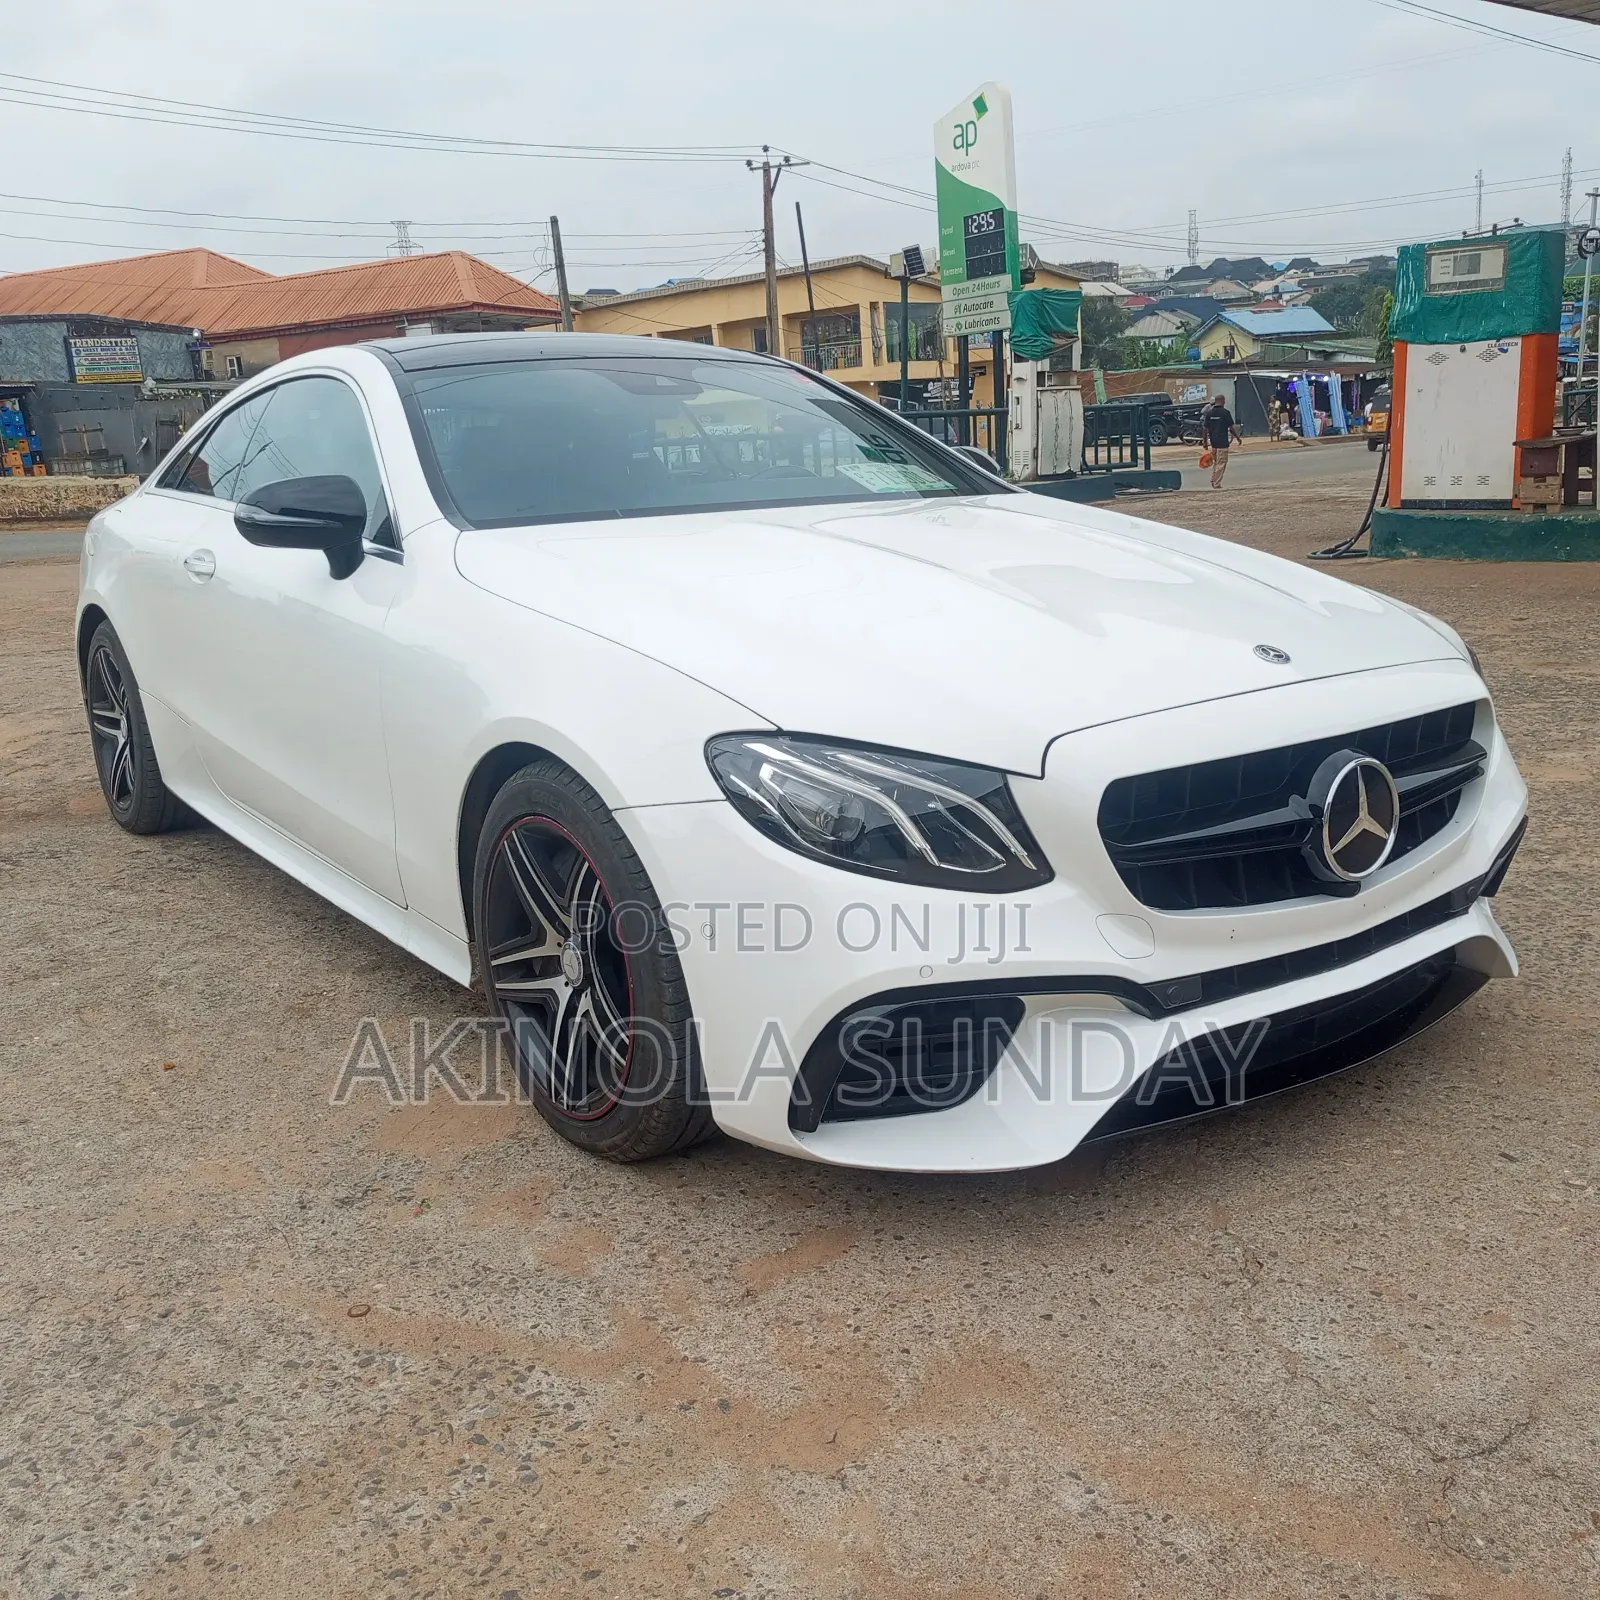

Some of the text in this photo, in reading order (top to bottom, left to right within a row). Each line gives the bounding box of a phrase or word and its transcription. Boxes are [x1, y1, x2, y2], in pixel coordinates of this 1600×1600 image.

[953, 120, 978, 157] ap
[951, 160, 980, 173] ardova plc
[941, 226, 954, 235] Petrol
[943, 248, 956, 256] Diesel
[943, 267, 963, 276] Kerosene
[952, 286, 970, 297] Open
[962, 300, 994, 313] Autocare
[964, 316, 1001, 330] Lubricants
[70, 338, 137, 347] TRENDSETTERS
